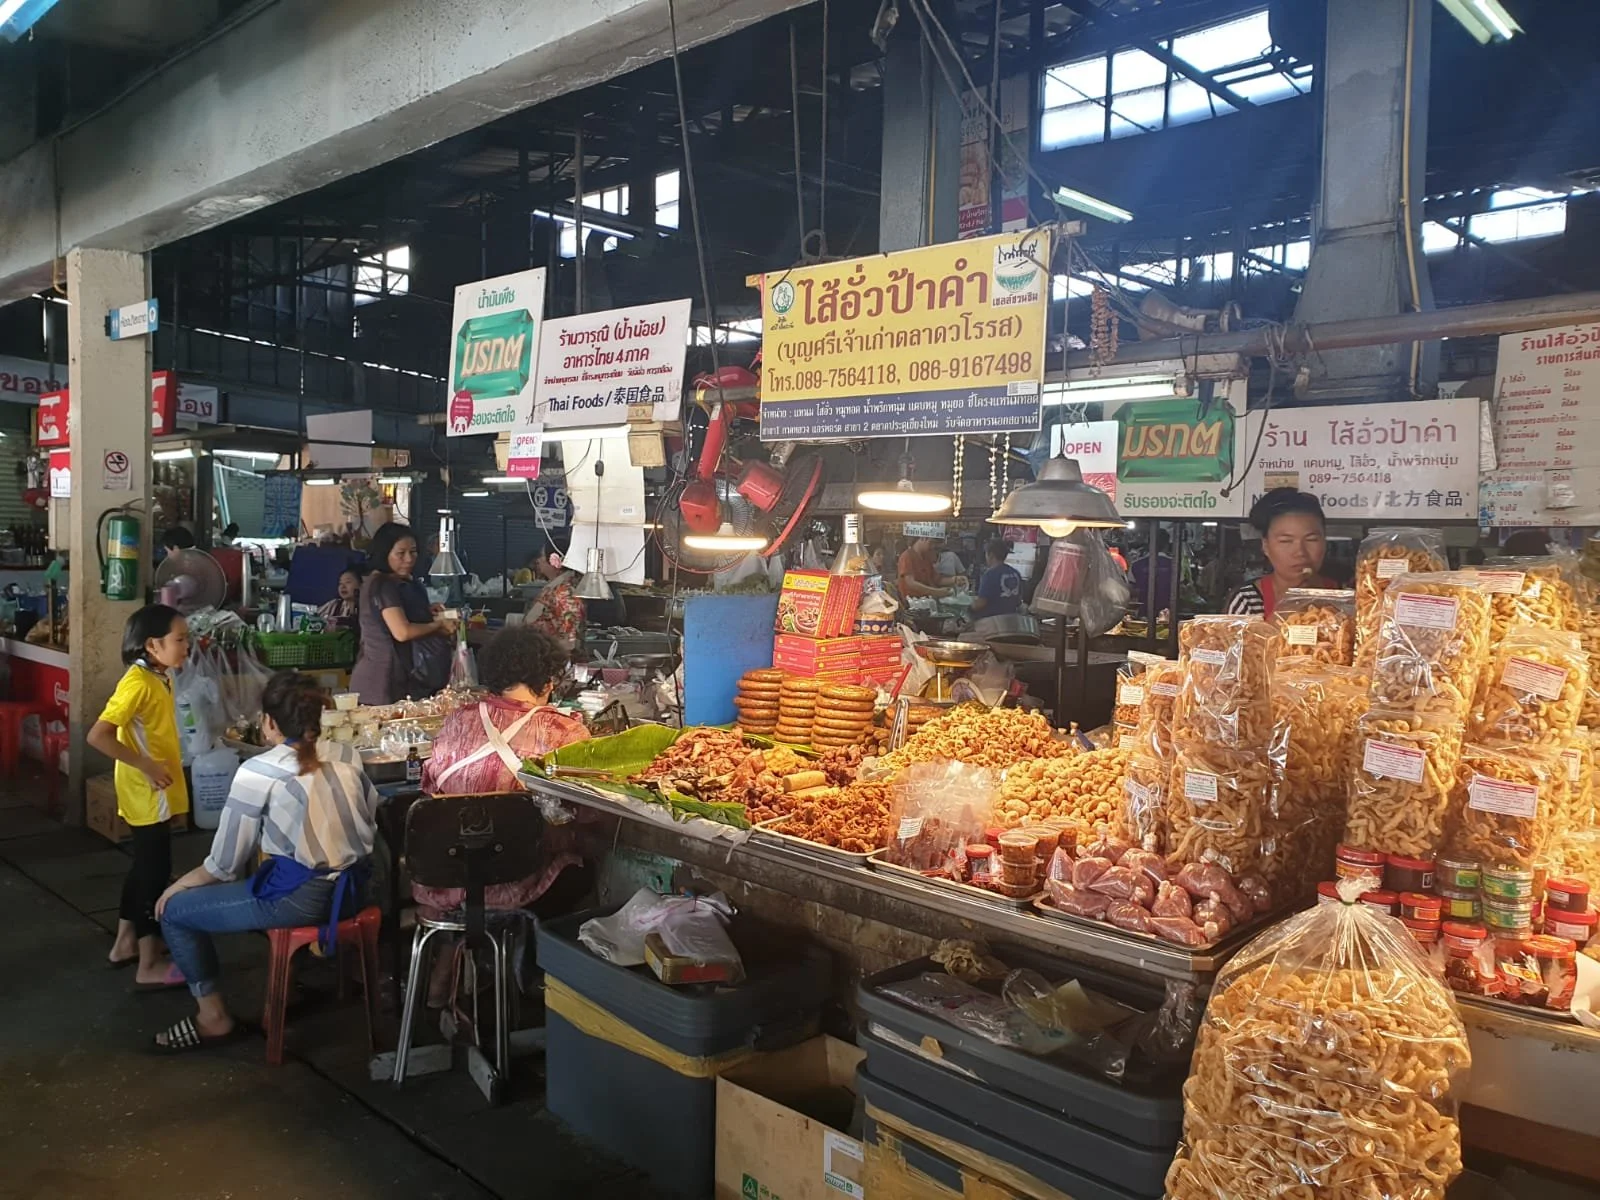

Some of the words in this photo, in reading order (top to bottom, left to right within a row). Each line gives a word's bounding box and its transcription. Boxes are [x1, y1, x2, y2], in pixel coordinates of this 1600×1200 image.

[477, 286, 516, 309] น้ำมันพืช
[797, 258, 988, 326] ไส้อั่วป้าคำ
[559, 325, 610, 349] ร้านวารุณี
[614, 315, 667, 341] (ป้าน้อย)
[460, 333, 526, 379] มรกต
[909, 351, 1032, 382] 086-9167498
[549, 395, 570, 412] Thai
[571, 394, 604, 411] Foods
[613, 384, 665, 405] 泰国食品
[472, 404, 516, 427] รองจะติดใจ
[516, 436, 535, 446] OPEN
[1121, 420, 1225, 460] มรกต
[1264, 423, 1308, 449] ร้าน
[1328, 416, 1458, 445] ไส้อั่วป้าคำ
[1065, 442, 1102, 455] OPEN
[1258, 456, 1294, 470] จำหน่าย
[1123, 491, 1217, 510] รับรองจะติดใจ
